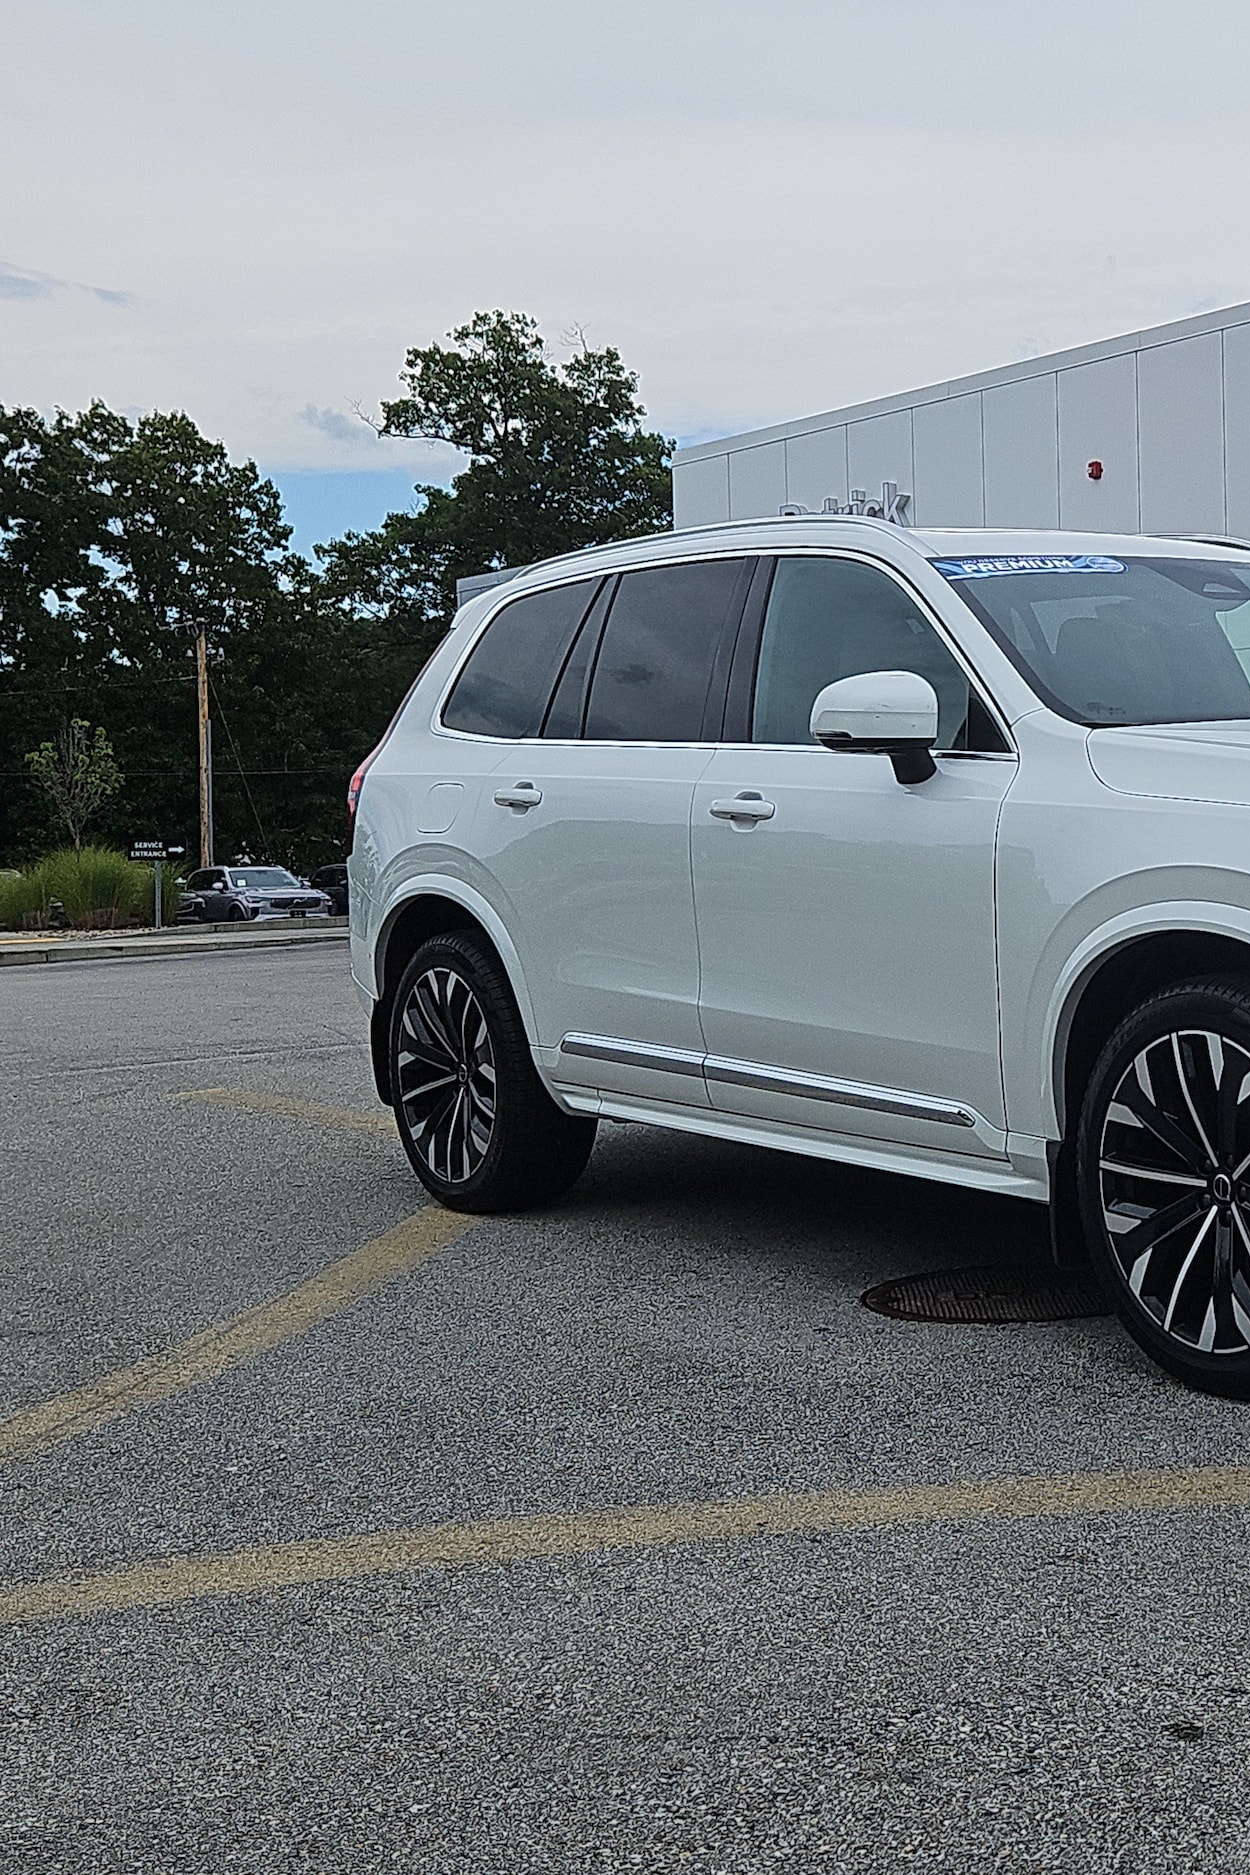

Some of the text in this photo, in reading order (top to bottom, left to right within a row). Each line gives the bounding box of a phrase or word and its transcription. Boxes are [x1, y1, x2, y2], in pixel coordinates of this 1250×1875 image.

[961, 559, 1075, 574] PREMIUM
[134, 841, 163, 849] SERVICE
[130, 850, 167, 858] ENTRANCE
